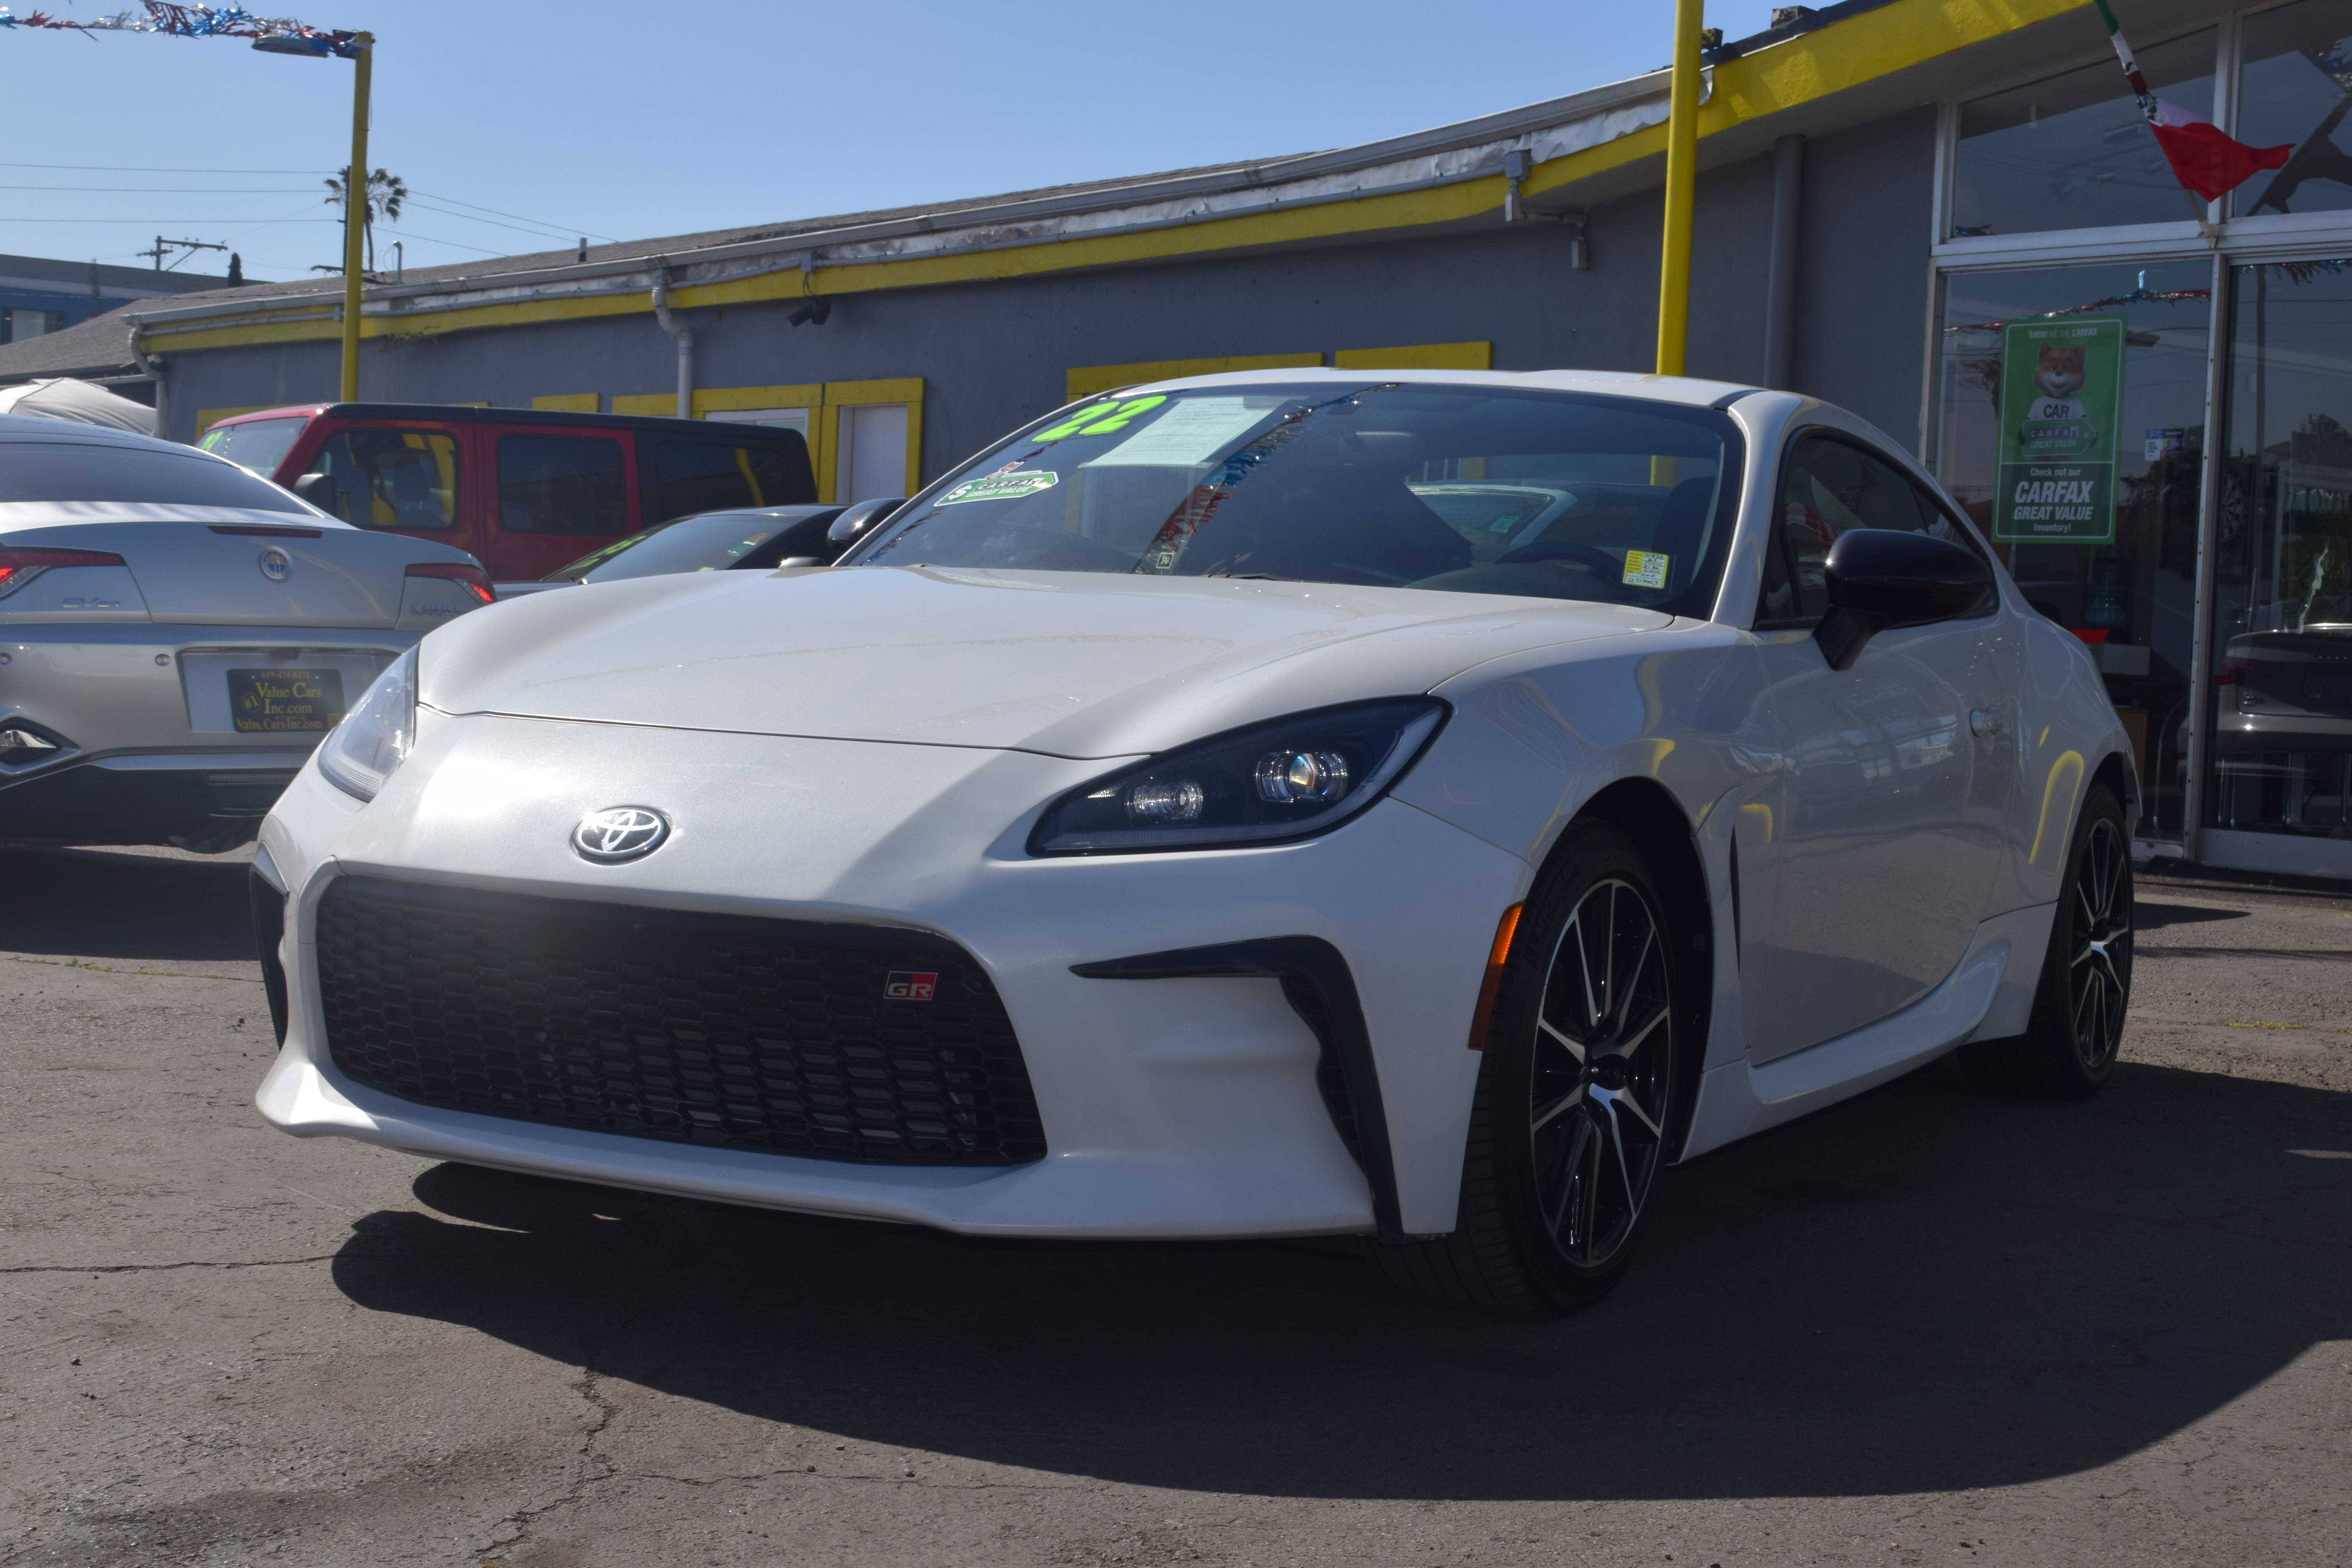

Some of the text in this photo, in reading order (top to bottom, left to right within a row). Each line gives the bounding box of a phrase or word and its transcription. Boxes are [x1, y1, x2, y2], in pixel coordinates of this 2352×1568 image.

[2028, 330, 2048, 339] SHOW
[2071, 328, 2098, 337] CARFAX
[1032, 395, 1167, 442] 22
[2043, 405, 2069, 419] CAR
[2030, 426, 2079, 438] CARFAX
[2031, 468, 2052, 477] Check
[977, 477, 1045, 490] CARFAX
[966, 489, 996, 498] GREAT
[2014, 481, 2094, 503] CARFAX
[2013, 506, 2094, 520] GREAT VALUE
[2034, 523, 2071, 534] Inventory!
[255, 682, 322, 698] Value Cars
[264, 699, 312, 714] Inc.com
[887, 983, 932, 997] GR
